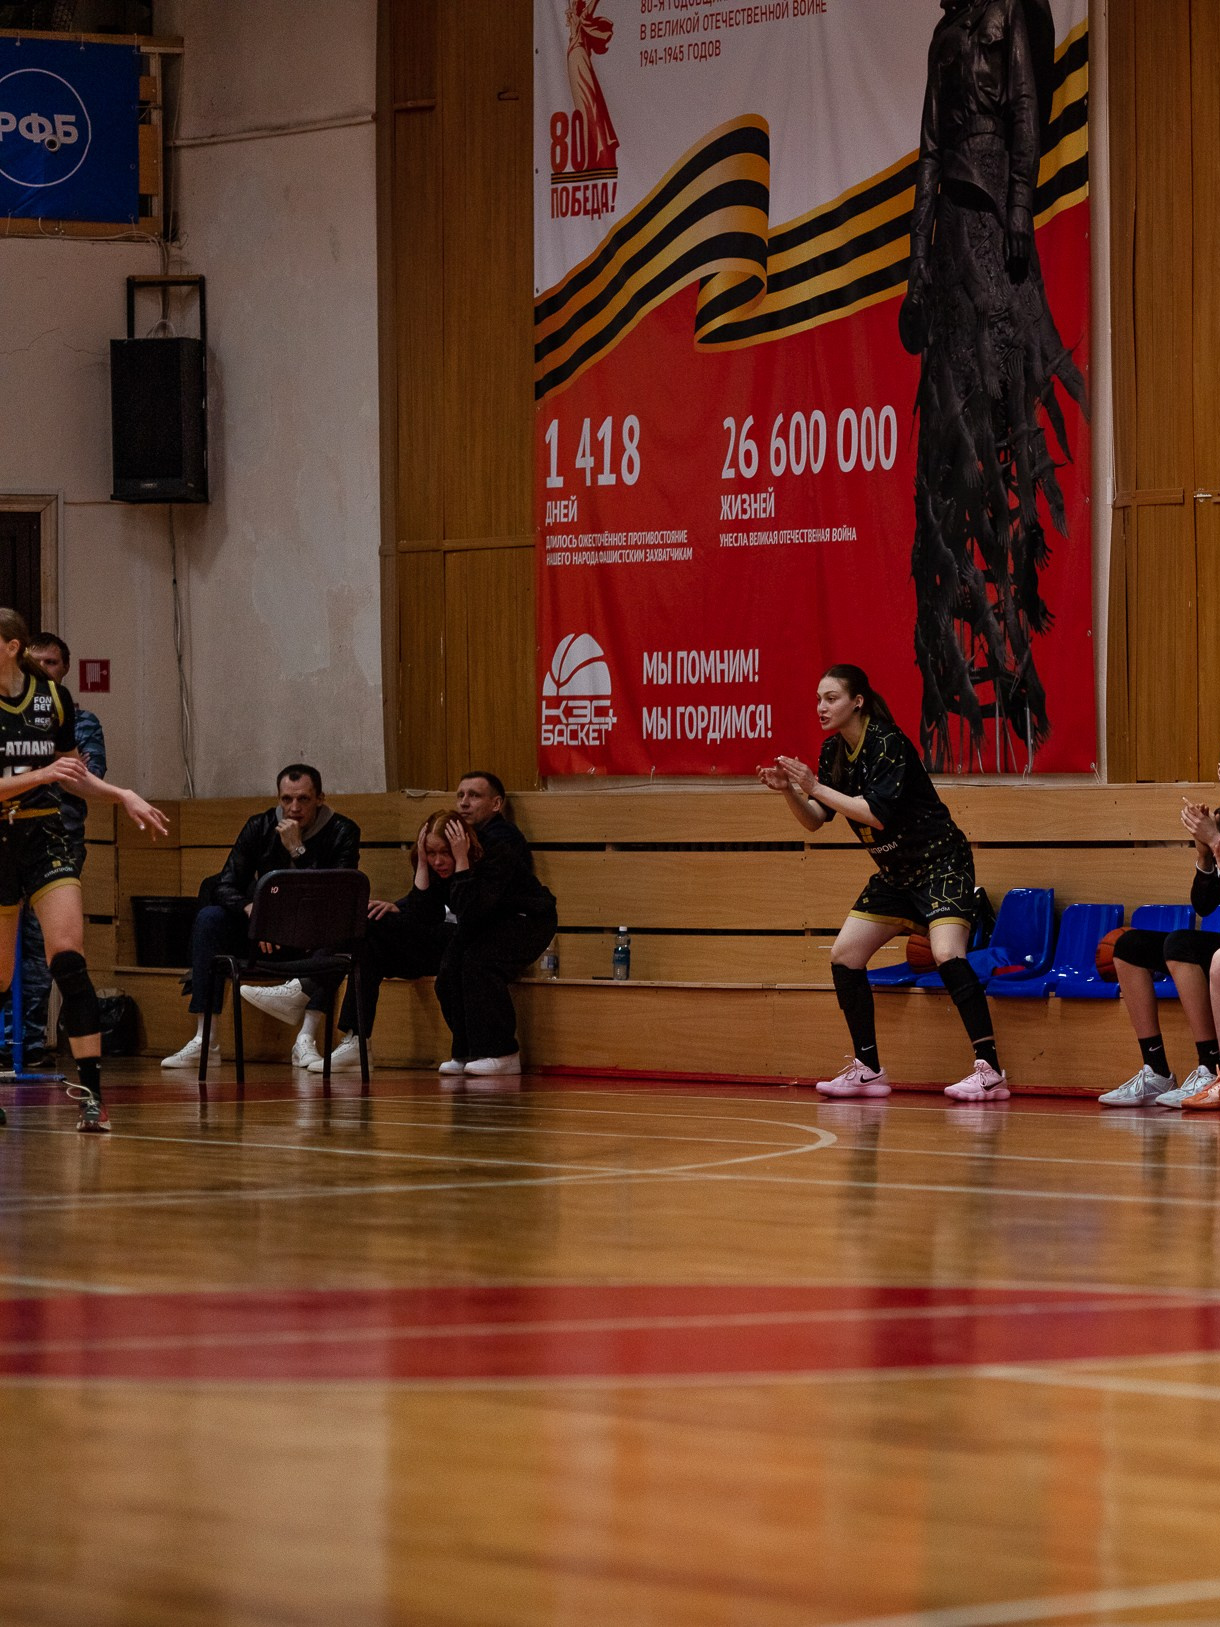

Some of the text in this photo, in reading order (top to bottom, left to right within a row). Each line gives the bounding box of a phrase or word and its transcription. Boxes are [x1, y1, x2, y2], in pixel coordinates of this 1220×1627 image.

[640, 24, 647, 40] В
[651, 13, 700, 39] ВЕЛИКОЙ
[703, 0, 789, 31] ОТЕЧЕСТВЕННОЙ
[687, 40, 721, 62] ГОДОВ
[0, 111, 79, 144] РФБ
[550, 109, 586, 173] 80
[551, 182, 617, 221] ПОБЕДА!
[545, 414, 641, 488] 1 418
[721, 405, 897, 479] 26 600 000
[545, 495, 578, 526] ДНЕЙ
[719, 487, 775, 520] ЖИЗНЕЙ
[546, 530, 688, 549] ДЛИЛОСЬ ОЖЕСТОЧЁННОЕ ПРОТИВОСТОЯНИЕ
[719, 525, 857, 547] УНЕСЛА ВЕЛИКАЯ ОТЕЧЕСТВЕННАЯ ВОЙНА
[546, 548, 692, 566] НАШЕГО НАРОДА ФАШИСТСКИМ ЗАХВАТЧИКАМ
[642, 649, 759, 684] МЫ ПОМНИМ!
[34, 703, 51, 711] BET
[541, 725, 609, 745] БАСКЕТ
[642, 704, 772, 744] МЫ ГОРДИМСЯ!
